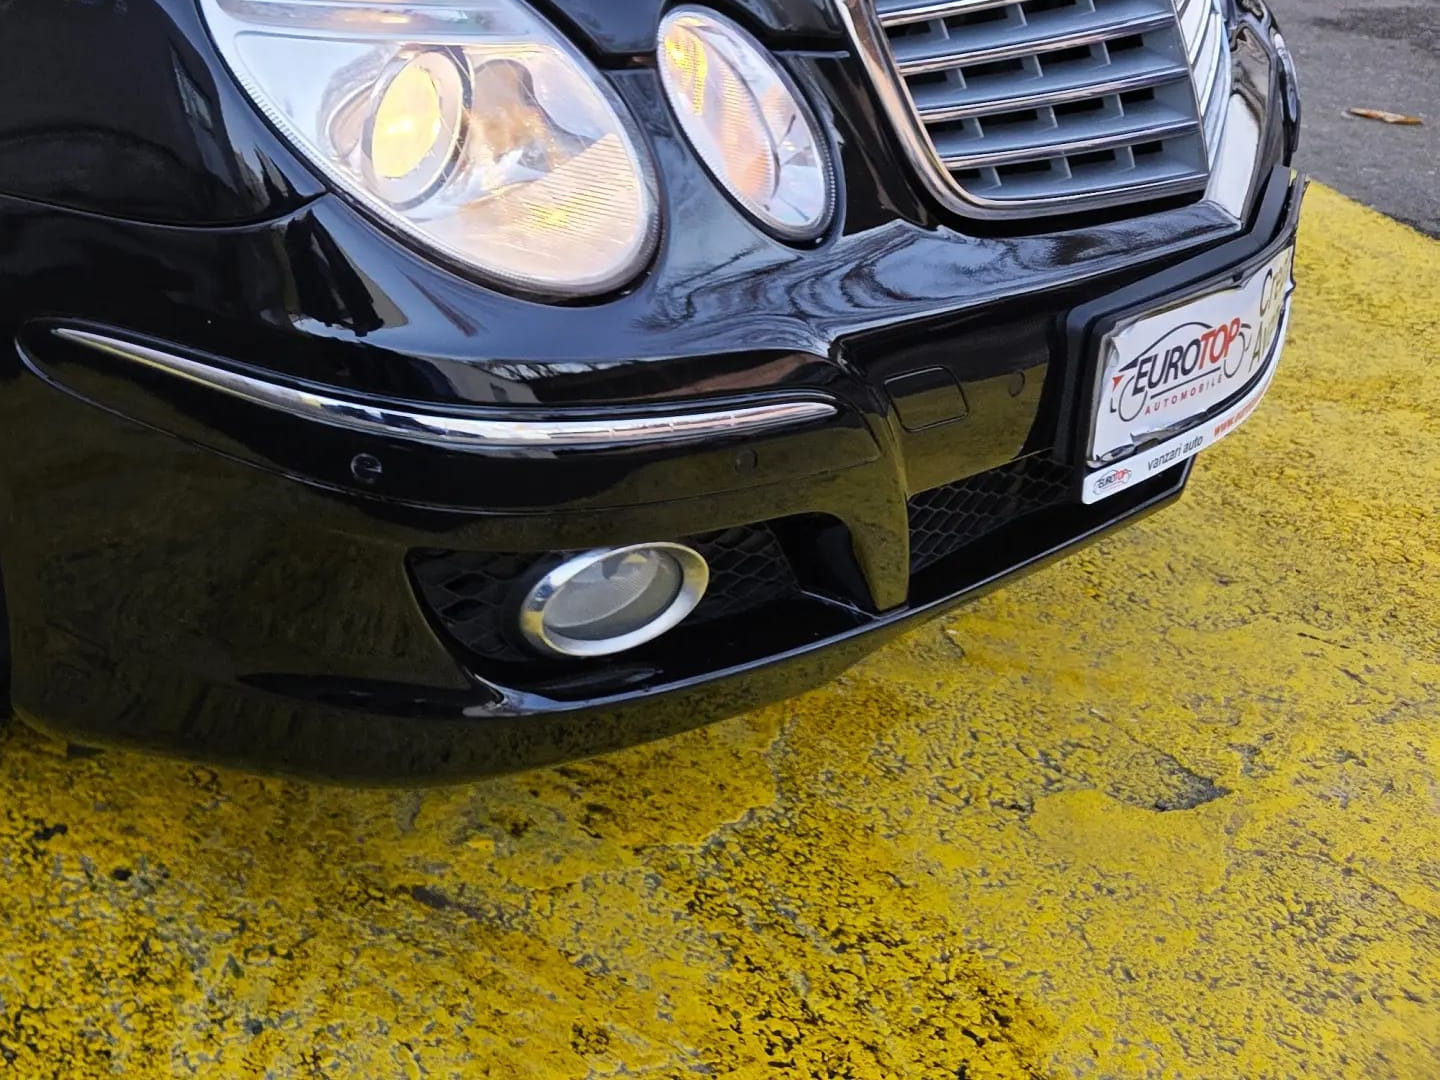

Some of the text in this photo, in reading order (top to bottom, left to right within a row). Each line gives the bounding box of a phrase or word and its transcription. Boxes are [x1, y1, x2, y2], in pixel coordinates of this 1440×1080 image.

[1131, 317, 1241, 397] EUROTOP
[1144, 373, 1223, 415] AUTOMOBILE
[1147, 442, 1183, 471] vanzari
[1183, 434, 1204, 454] auto
